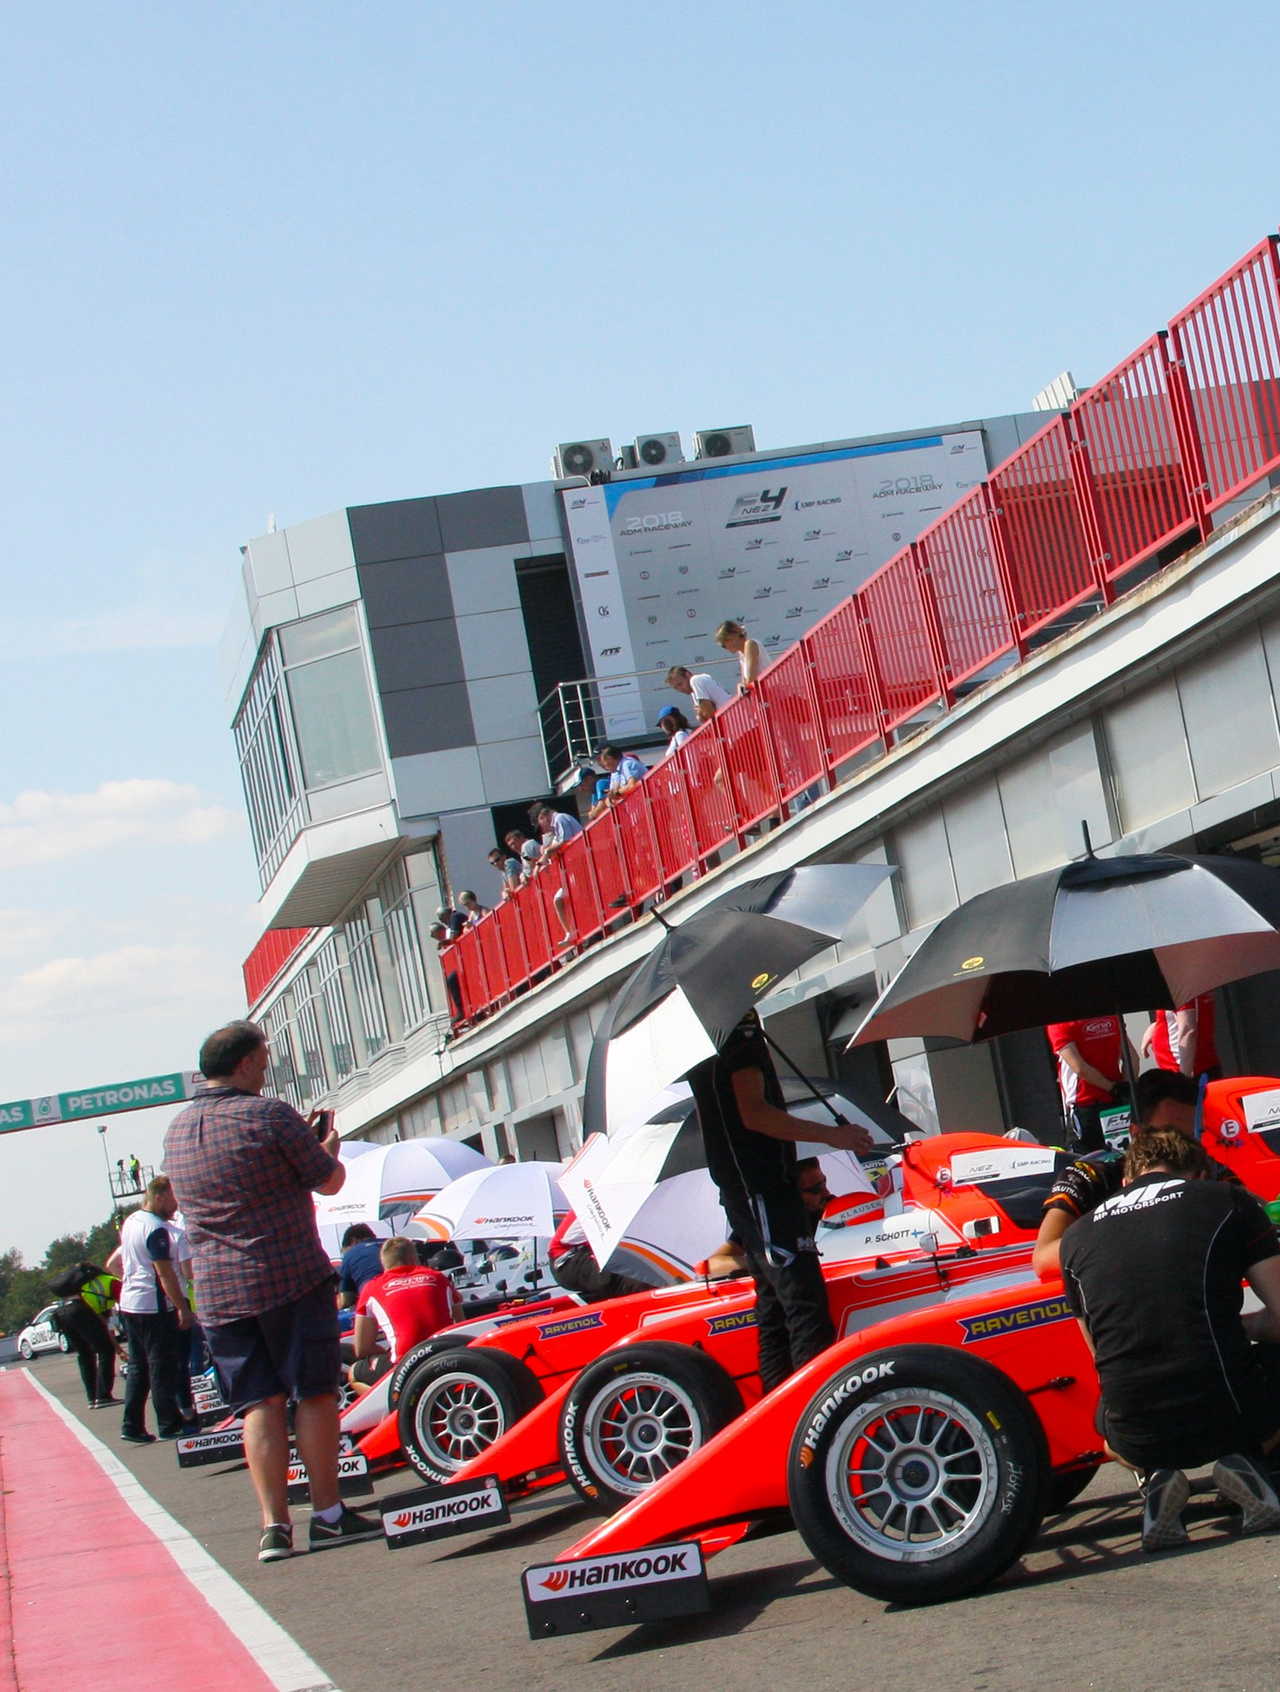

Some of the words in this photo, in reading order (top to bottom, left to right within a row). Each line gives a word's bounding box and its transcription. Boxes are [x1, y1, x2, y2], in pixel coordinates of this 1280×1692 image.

[879, 474, 935, 491] 2018
[896, 484, 943, 496] RACEWAY
[742, 505, 771, 515] NEZ
[817, 497, 842, 506] RACING
[620, 528, 643, 537] ADM
[644, 520, 693, 534] RACEWAY
[626, 511, 685, 530] 2018
[68, 1079, 176, 1112] PETRONAS
[1224, 1121, 1235, 1136] E
[969, 1164, 993, 1173] NEZ
[1093, 1211, 1108, 1222] MP
[1111, 1191, 1184, 1216] MOTORSPORT
[875, 1229, 910, 1243] SCHOTT
[545, 1318, 597, 1336] RAVENOL
[714, 1313, 757, 1330] RAVE
[971, 1303, 1073, 1335] RAVENOL
[805, 1361, 896, 1449] HanKOOK
[406, 1444, 450, 1485] anKOOK
[412, 1494, 492, 1525] HanKOOK
[568, 1552, 688, 1588] HanKOOK
